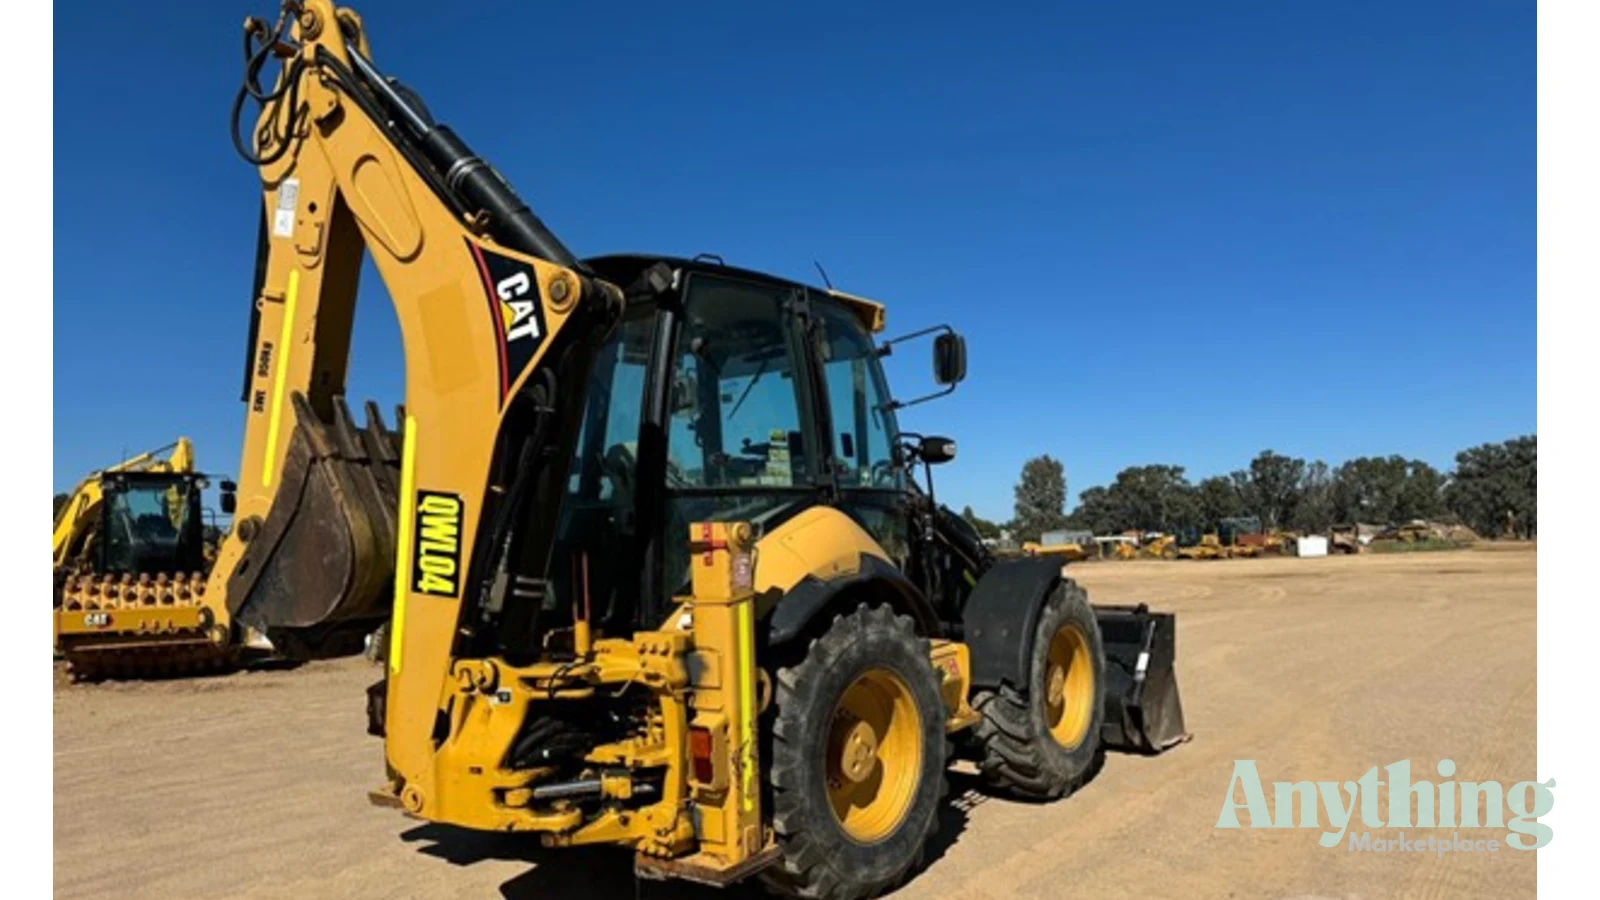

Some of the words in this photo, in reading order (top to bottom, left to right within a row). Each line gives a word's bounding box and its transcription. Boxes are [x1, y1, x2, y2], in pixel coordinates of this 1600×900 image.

[497, 271, 540, 342] CAT
[418, 495, 460, 593] QWL04
[84, 613, 107, 627] CAT
